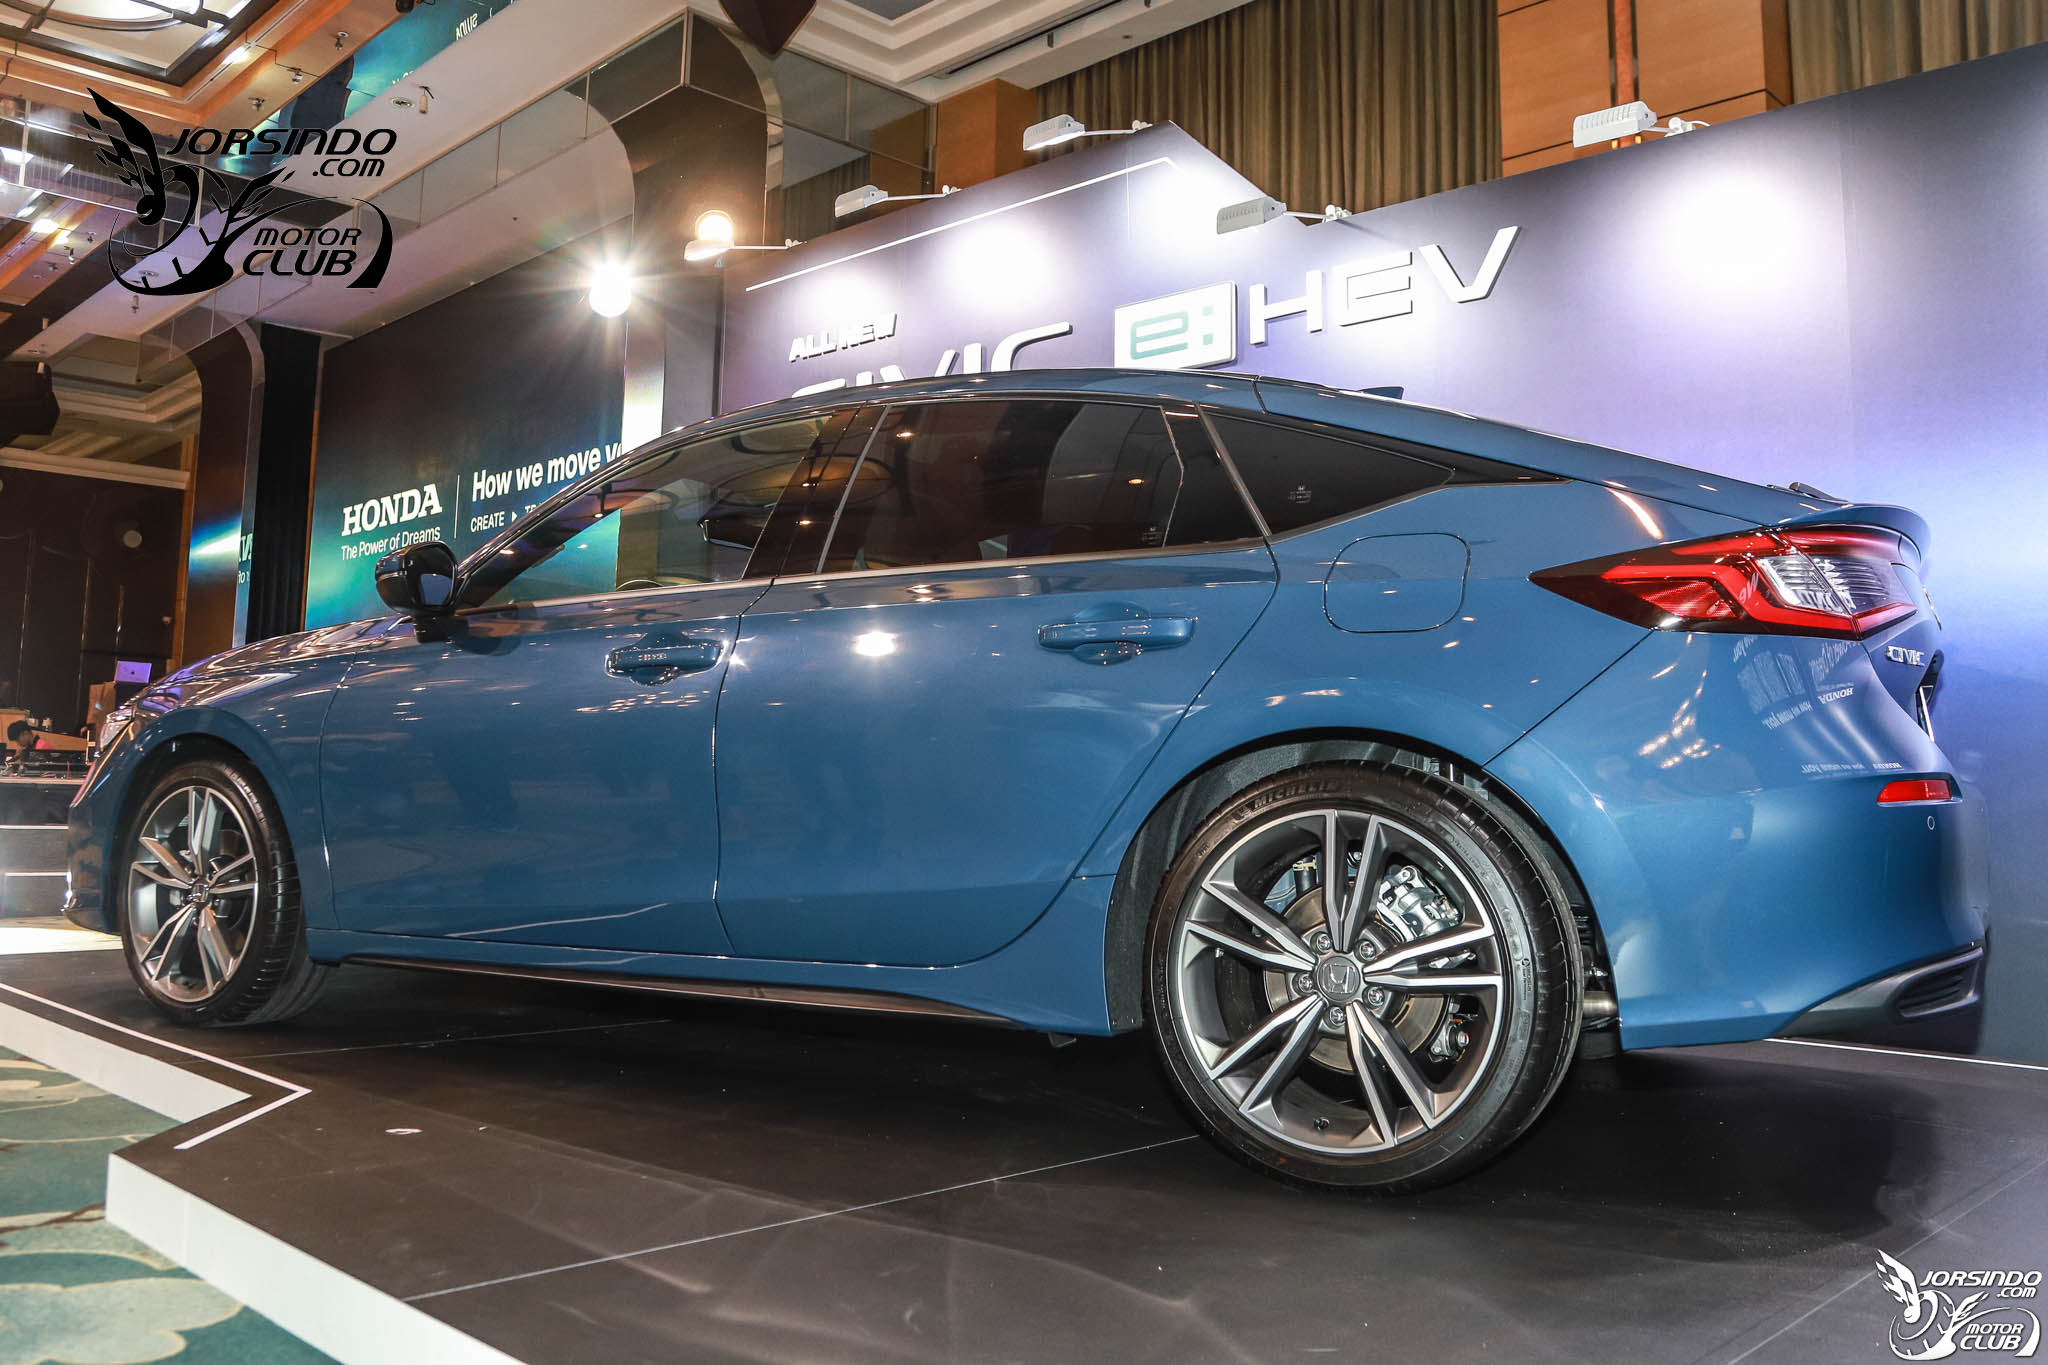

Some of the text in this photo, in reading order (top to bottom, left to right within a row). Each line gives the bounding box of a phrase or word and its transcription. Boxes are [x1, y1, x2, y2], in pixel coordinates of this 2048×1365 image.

[789, 331, 838, 364] ALL
[840, 312, 898, 351] NEW
[472, 468, 513, 502] How
[516, 461, 544, 492] we
[547, 446, 602, 485] move
[341, 483, 443, 537] HONDA
[470, 510, 506, 533] CREATE
[341, 526, 441, 561] The Power of Dreams
